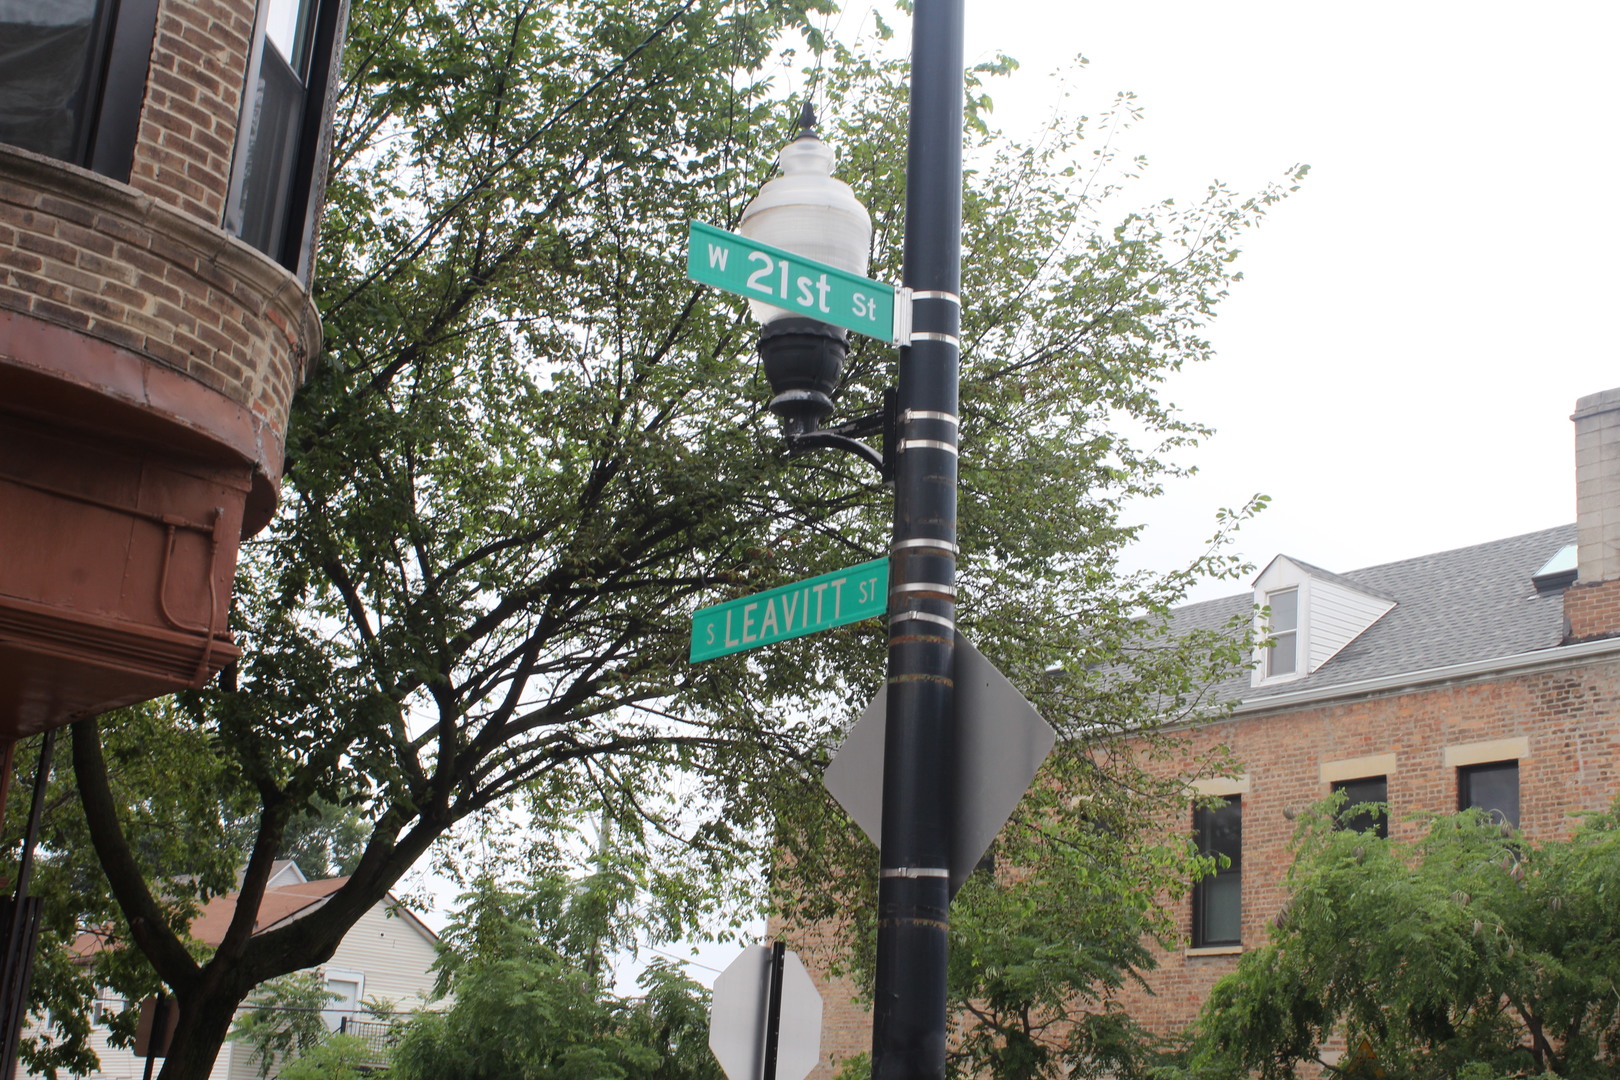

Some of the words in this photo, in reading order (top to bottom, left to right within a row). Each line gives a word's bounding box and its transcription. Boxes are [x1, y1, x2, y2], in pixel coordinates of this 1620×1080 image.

[708, 243, 729, 272] W
[746, 251, 831, 314] 21st
[851, 292, 876, 321] St
[706, 623, 715, 645] S
[724, 578, 847, 648] LEAVITT
[858, 577, 878, 604] ST
